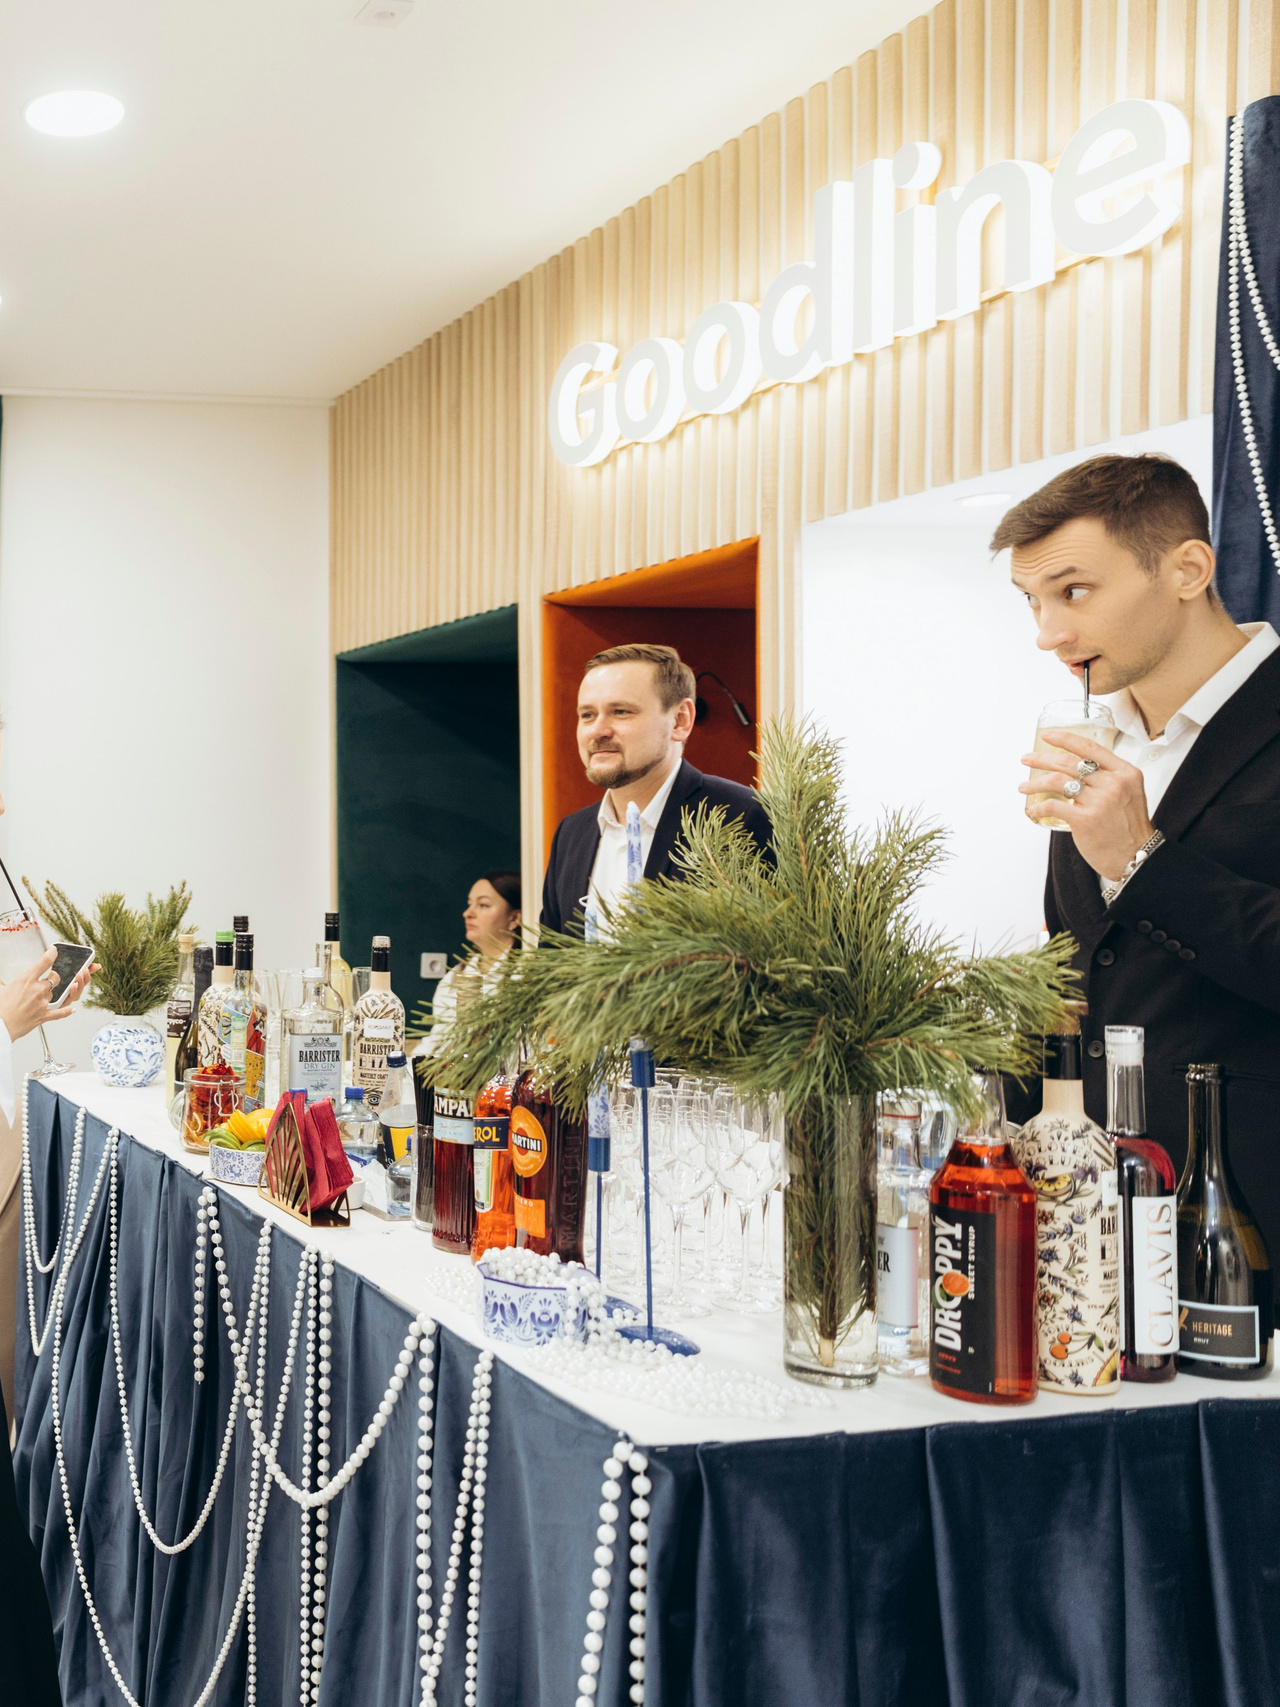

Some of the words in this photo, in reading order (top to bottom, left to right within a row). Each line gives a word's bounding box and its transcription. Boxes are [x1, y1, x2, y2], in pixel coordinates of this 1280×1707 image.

[548, 98, 1191, 468] Goodline
[299, 1050, 341, 1063] BARRISTER
[934, 1214, 962, 1351] DROPPY
[1147, 1203, 1174, 1347] CLAVIS
[1192, 1321, 1233, 1337] HERITAGE
